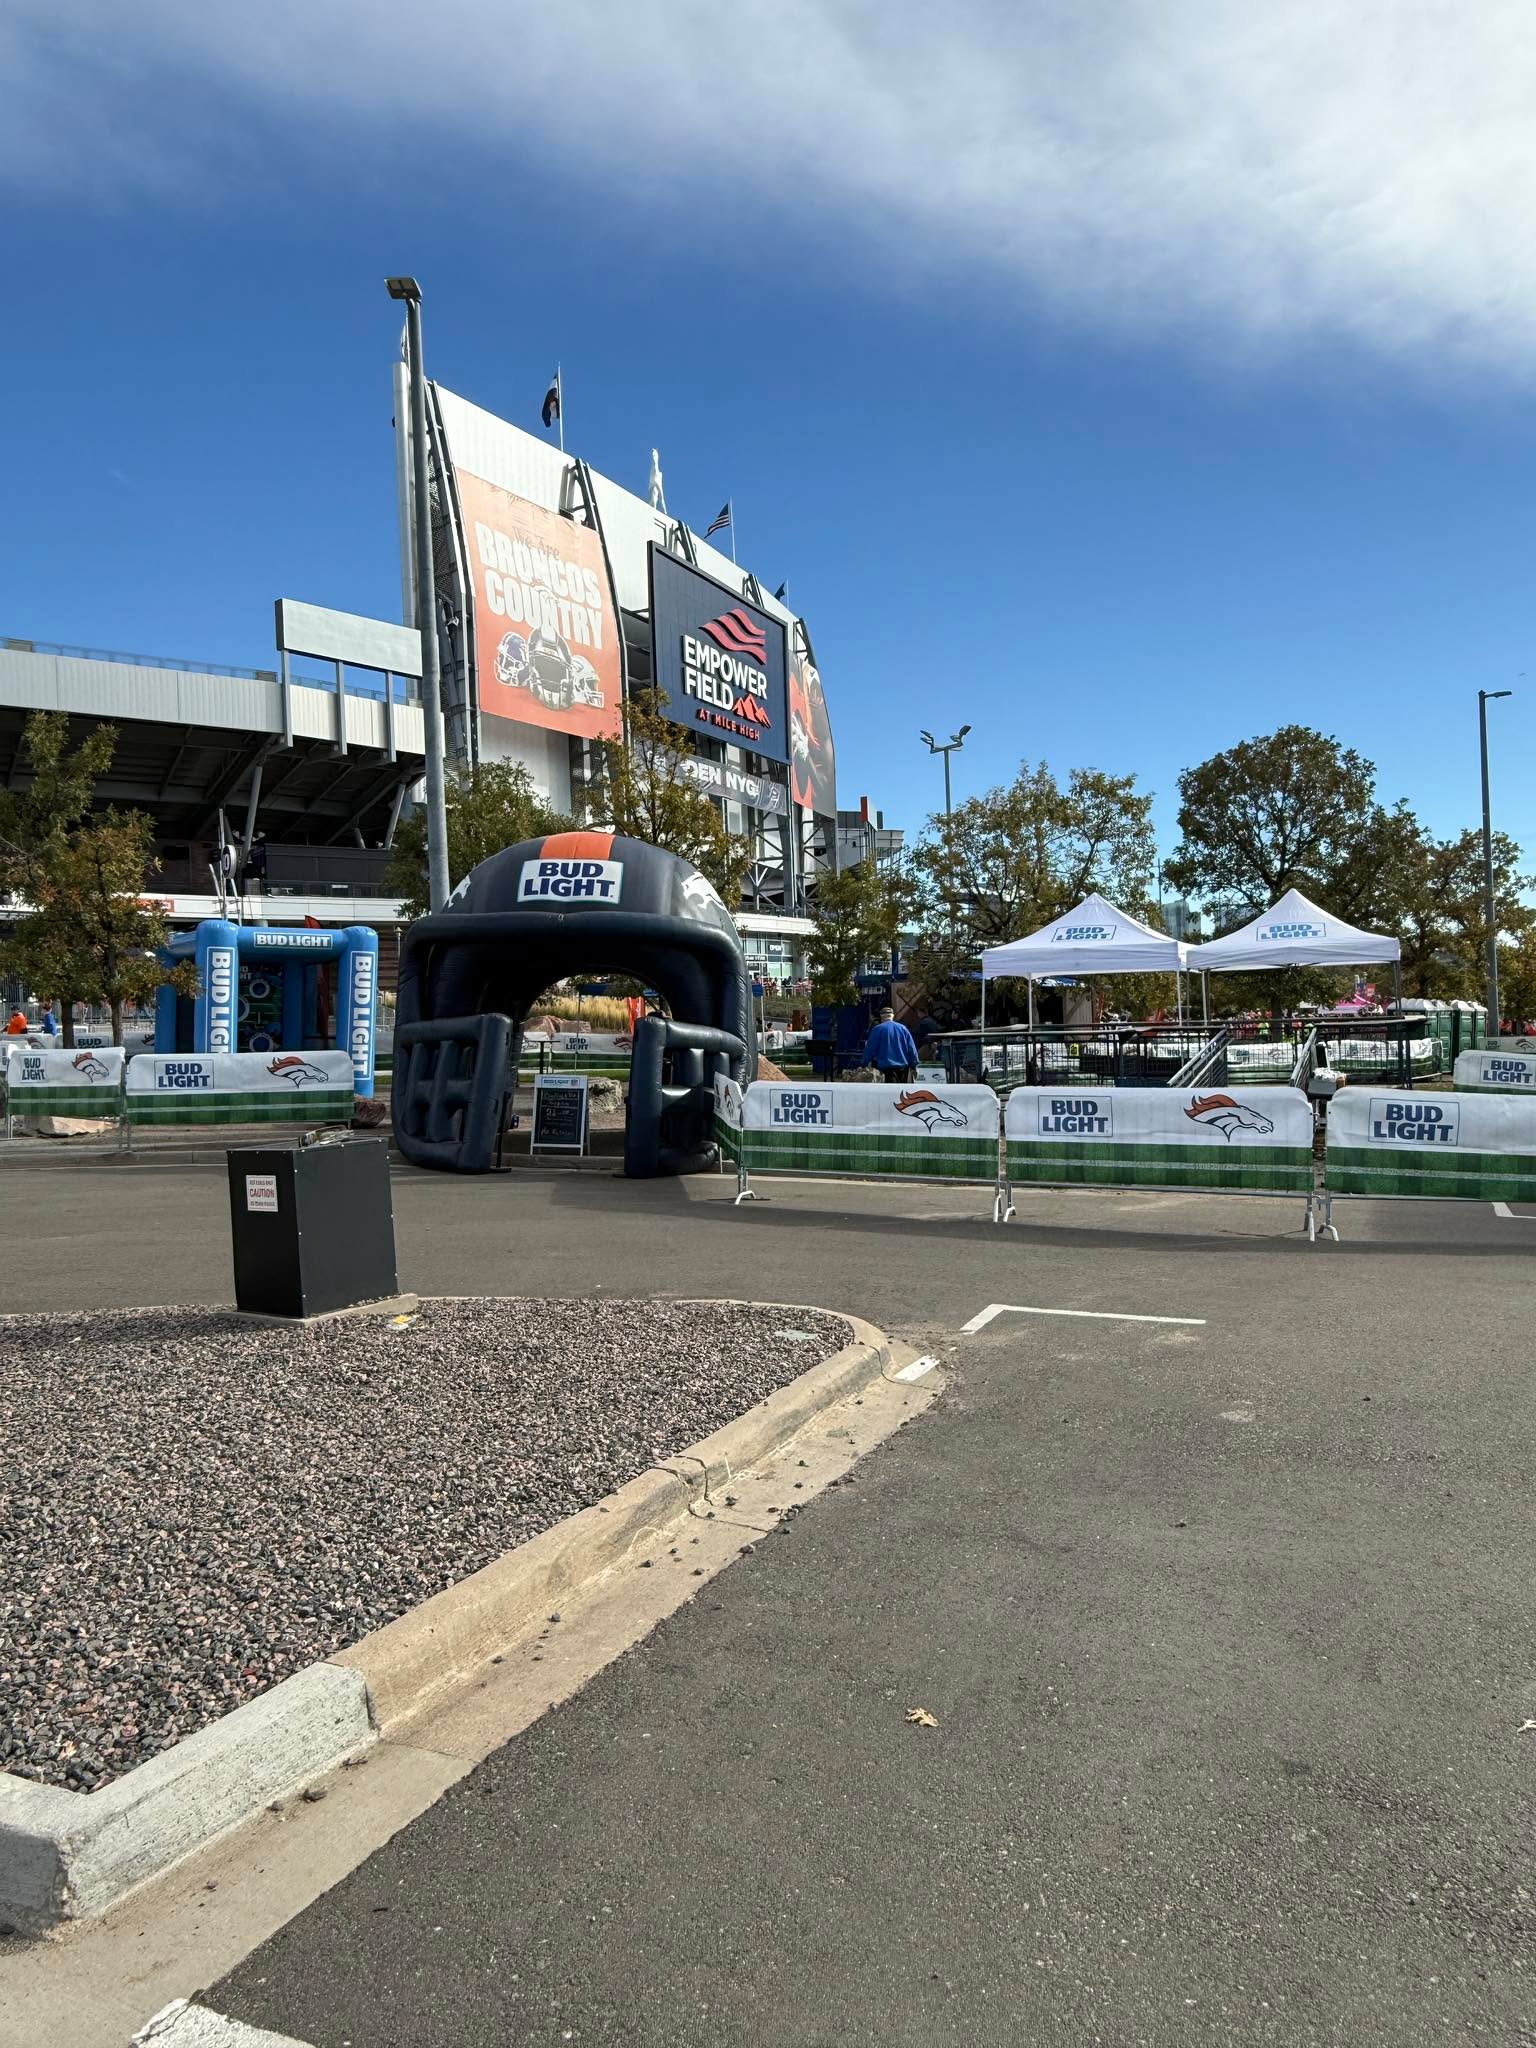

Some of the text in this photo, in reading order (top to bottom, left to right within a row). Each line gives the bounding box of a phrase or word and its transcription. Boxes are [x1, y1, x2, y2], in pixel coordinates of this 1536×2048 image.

[474, 521, 602, 609] BRONCOS
[485, 569, 602, 650] COUNTRY
[683, 634, 767, 700] EMPOWER
[685, 666, 734, 711] FIELD
[698, 708, 760, 741] AT MILE HIGH
[683, 758, 722, 785] DEN
[538, 862, 604, 878] BUD
[524, 878, 615, 897] LIGHT
[1056, 932, 1111, 941] LIGHT
[1066, 926, 1105, 935] BUD
[1261, 930, 1321, 940] LIGHT
[1269, 924, 1313, 933] BUD
[256, 935, 330, 947] BUD LIGHT
[211, 952, 231, 1004] BUD
[354, 956, 372, 1005] BUD
[77, 1038, 102, 1046] BUD
[352, 1007, 370, 1076] LIGHT
[23, 1057, 41, 1068] BUD
[165, 1063, 203, 1075] BUD
[1490, 1060, 1527, 1072] BUD
[21, 1069, 46, 1081] LIGHT
[158, 1075, 210, 1088] LIGHT
[1483, 1070, 1533, 1084] LIGHT
[781, 1093, 822, 1109] BUD
[1051, 1100, 1098, 1116] BUD
[773, 1108, 829, 1124] LIGHT
[1385, 1103, 1443, 1123] BUD
[1042, 1116, 1109, 1133] LIGHT
[1373, 1121, 1454, 1142] LIGHT
